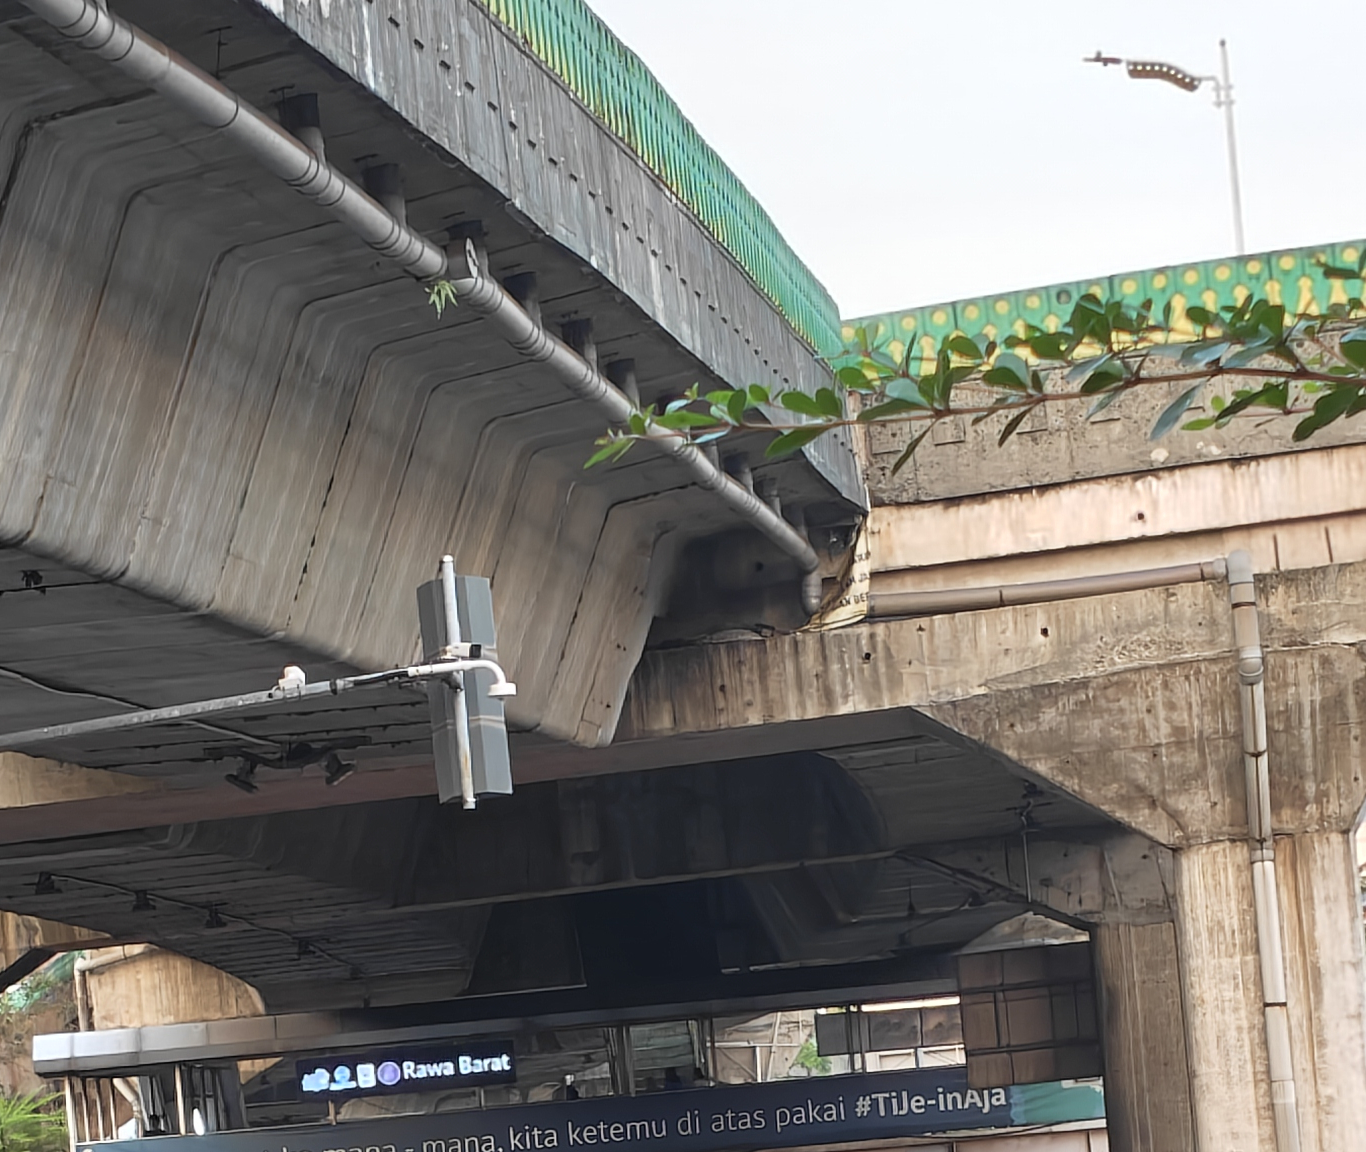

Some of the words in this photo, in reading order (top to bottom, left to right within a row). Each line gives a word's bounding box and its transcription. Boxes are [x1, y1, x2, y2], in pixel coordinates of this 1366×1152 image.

[402, 1060, 455, 1080] Rawa
[458, 1053, 512, 1074] Barat
[509, 1125, 558, 1151] kita
[567, 1121, 667, 1146] ketemu
[677, 1110, 700, 1136] di
[711, 1108, 766, 1133] atas
[775, 1096, 846, 1134] pakai
